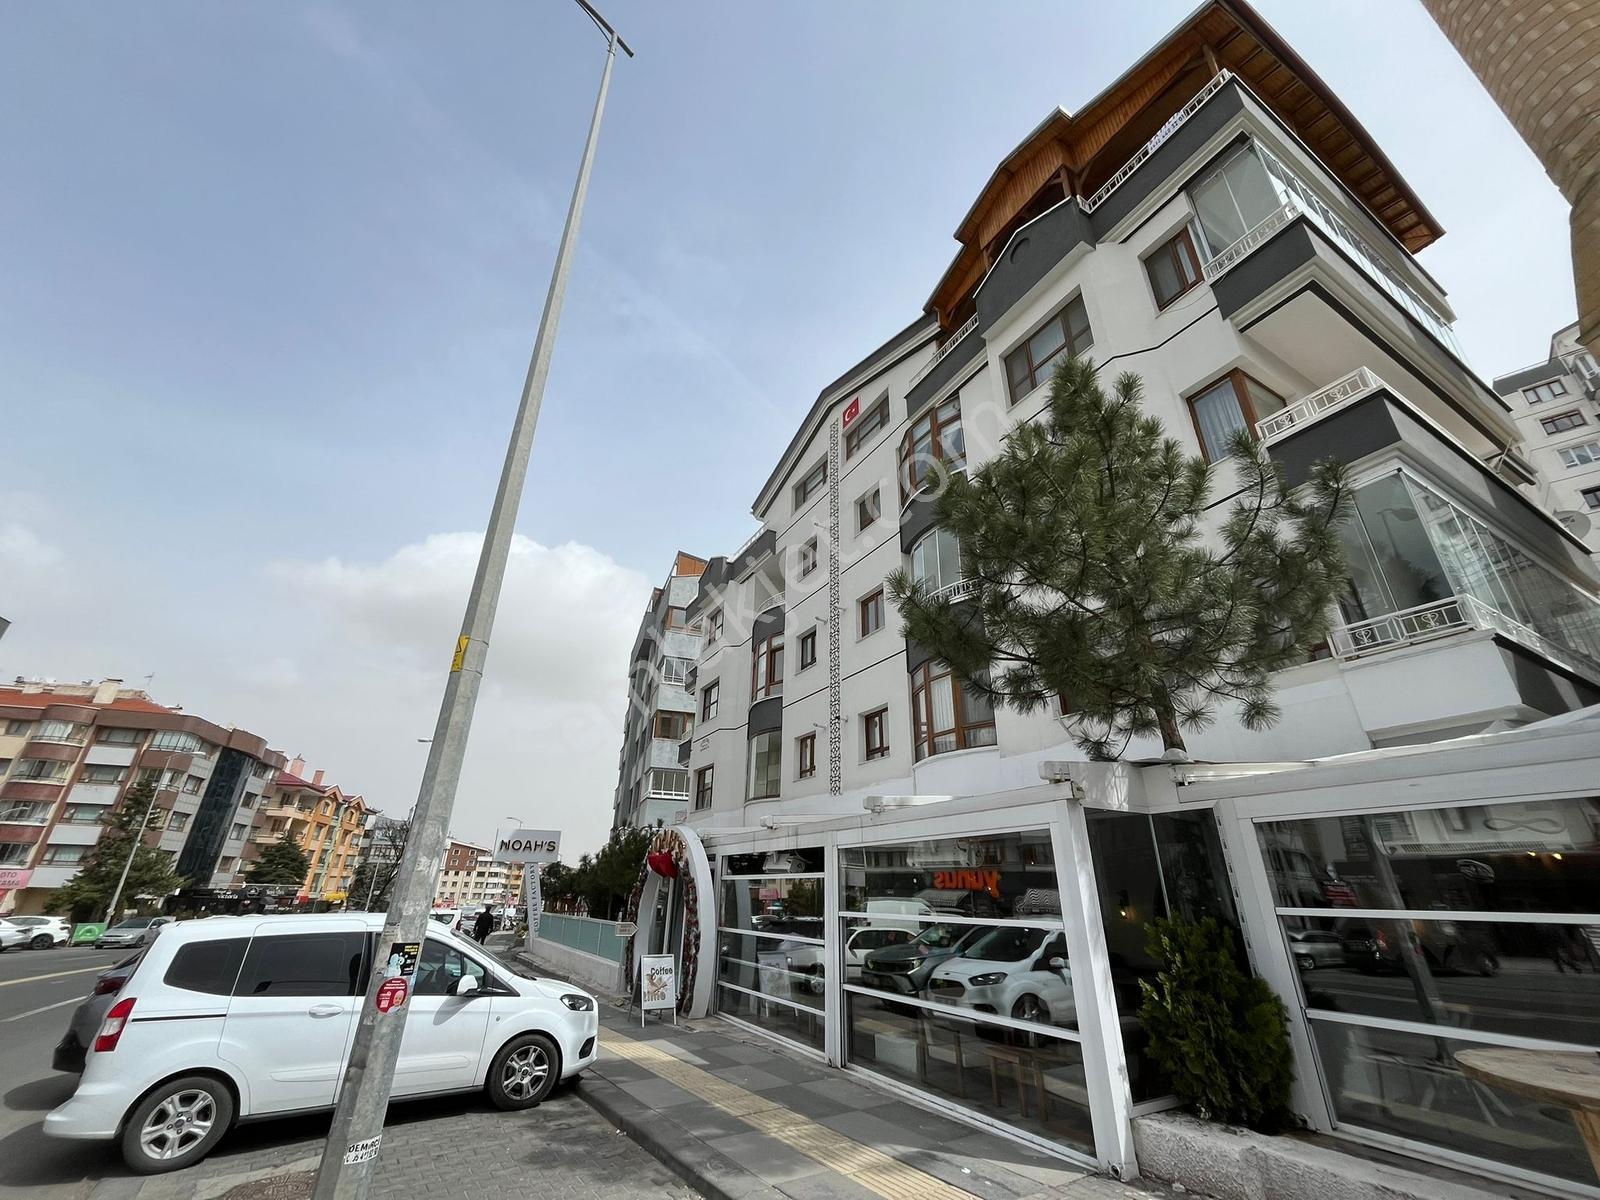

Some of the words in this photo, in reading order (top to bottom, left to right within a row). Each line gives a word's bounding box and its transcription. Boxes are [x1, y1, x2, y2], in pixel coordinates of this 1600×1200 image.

[499, 839, 556, 852] NOAH'S
[529, 864, 538, 899] FACTORY
[530, 901, 539, 932] COFFEE
[650, 967, 673, 977] Coffee
